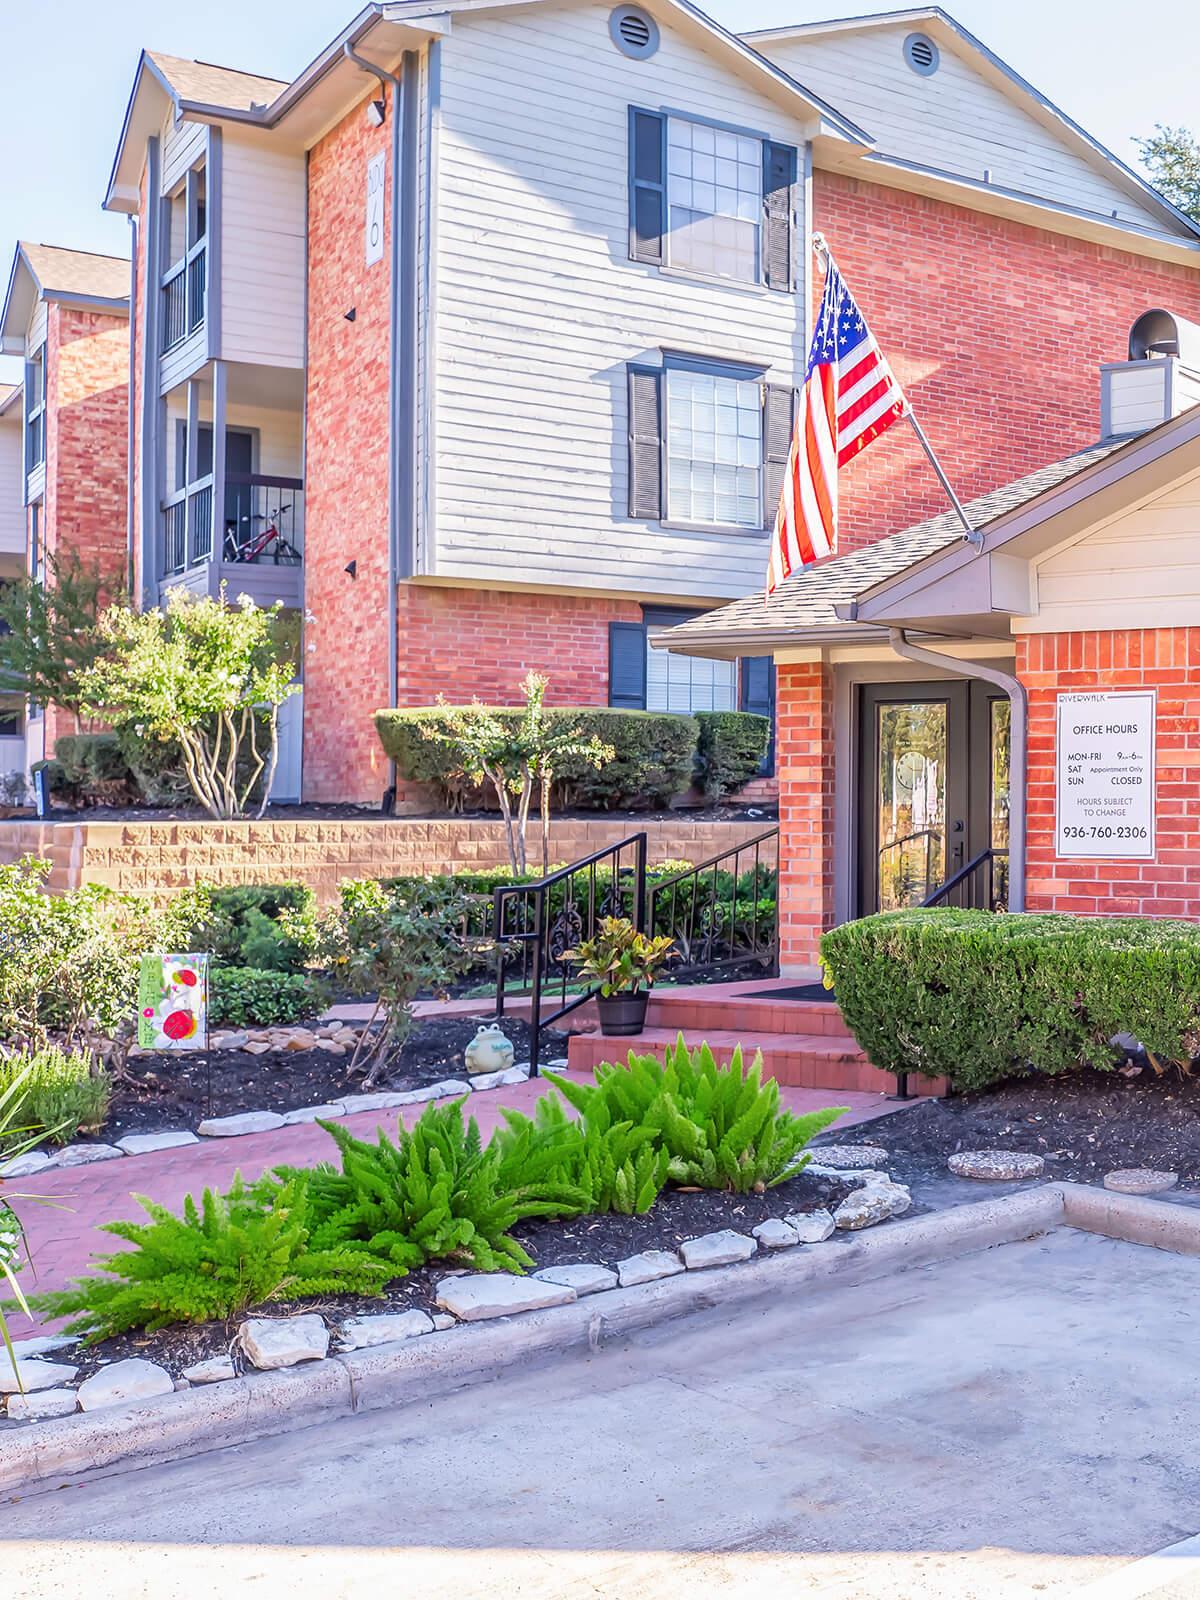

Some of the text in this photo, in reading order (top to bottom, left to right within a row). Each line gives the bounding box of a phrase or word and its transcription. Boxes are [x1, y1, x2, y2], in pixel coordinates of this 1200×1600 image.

[1073, 724, 1138, 735] OFFICE HOURS
[1067, 752, 1102, 761] MON-FRI
[1067, 765, 1082, 773] SAT
[1067, 776, 1143, 785] SUN CLOSED
[1077, 797, 1133, 806] HOURS SUBJECT
[1095, 808, 1126, 817] CHANGE
[1063, 826, 1148, 839] 936-760-2306
